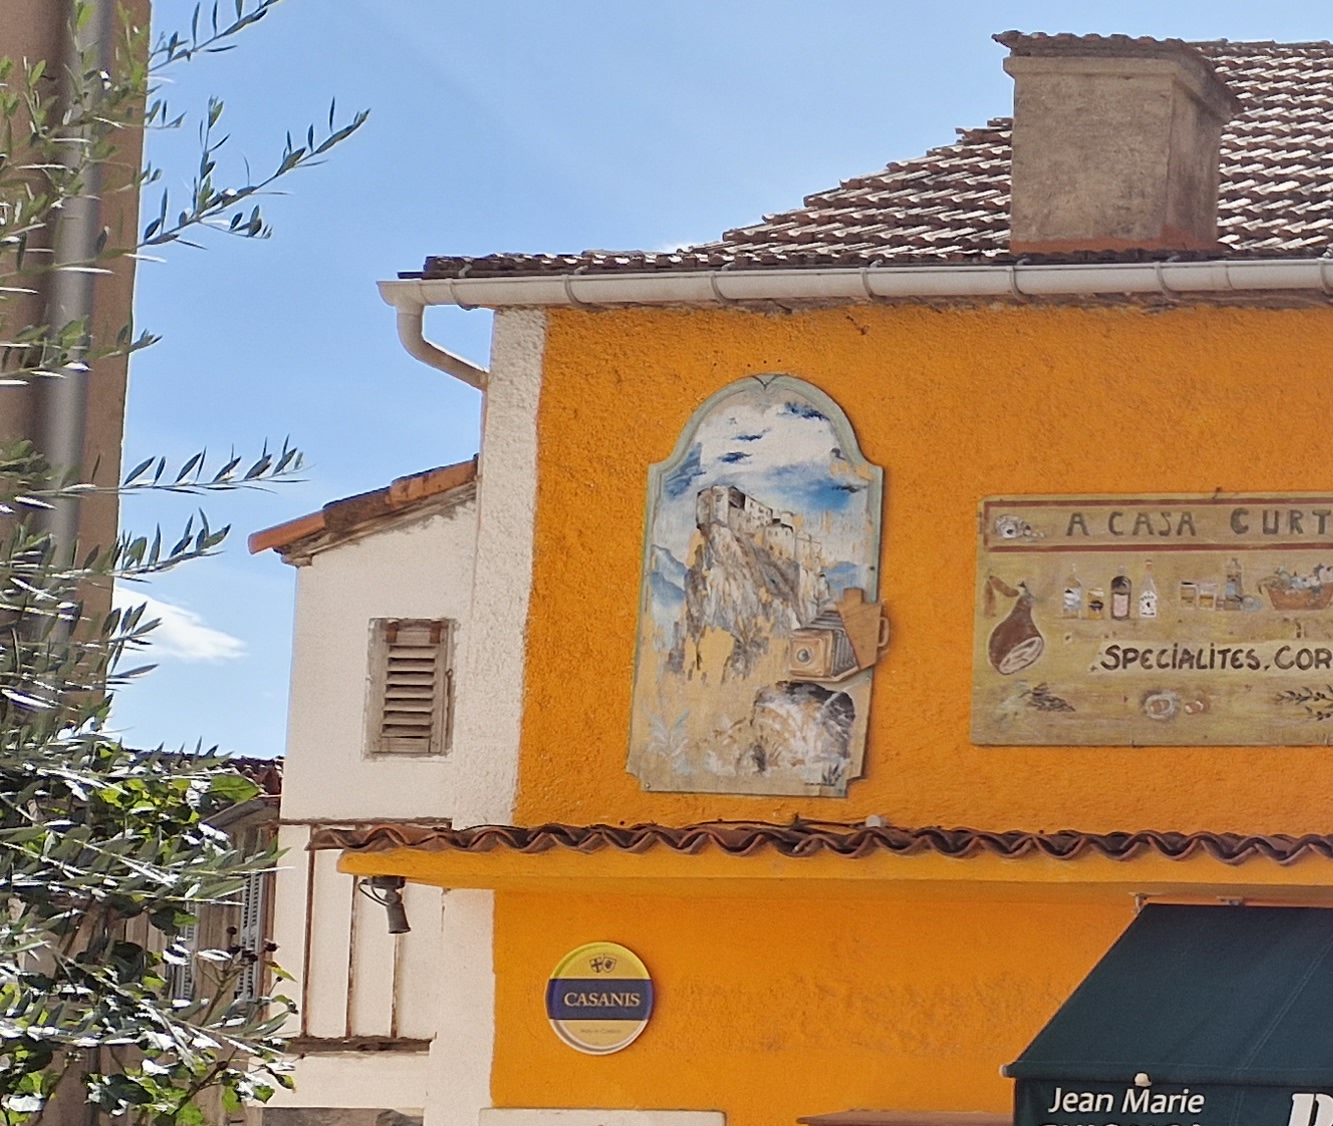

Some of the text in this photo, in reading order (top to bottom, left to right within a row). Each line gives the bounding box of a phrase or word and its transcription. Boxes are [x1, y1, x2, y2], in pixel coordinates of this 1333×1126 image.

[1066, 510, 1090, 537] A
[1108, 510, 1198, 537] CASA
[564, 992, 640, 1007] CASANIS
[1048, 1087, 1205, 1113] Jean Marie
